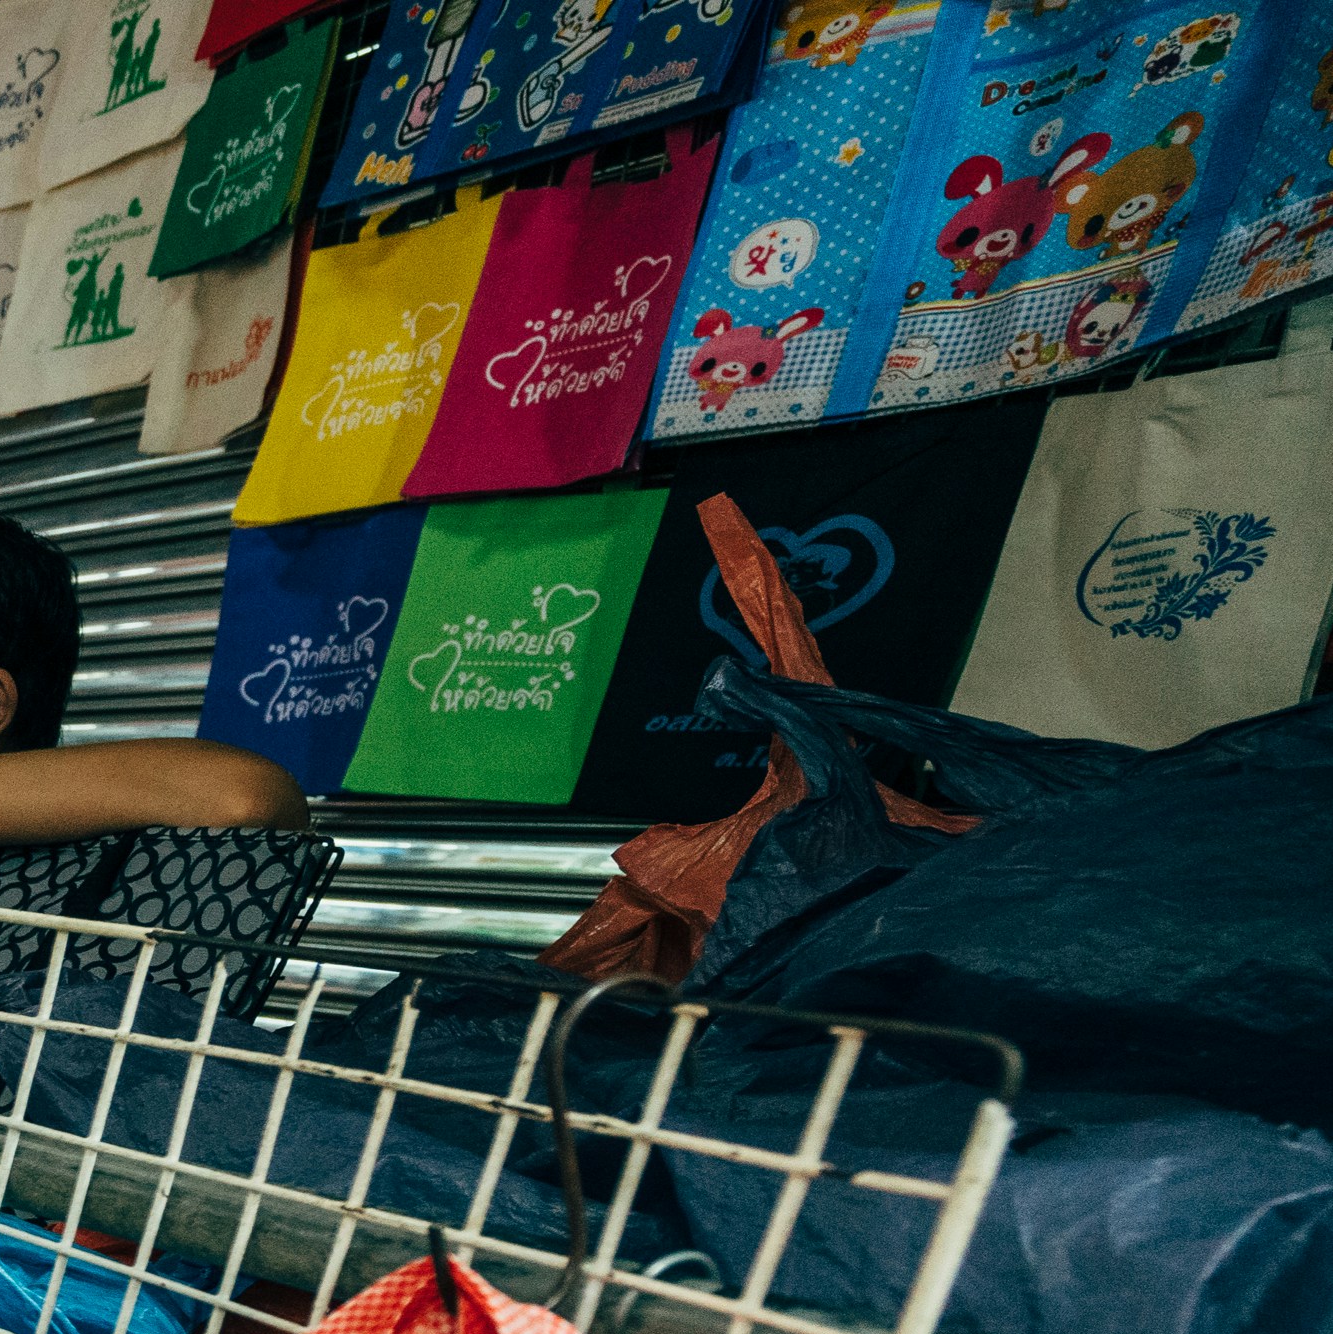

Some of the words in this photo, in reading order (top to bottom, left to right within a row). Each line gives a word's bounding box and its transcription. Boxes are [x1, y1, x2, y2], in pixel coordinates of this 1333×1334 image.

[485, 336, 633, 408] ให้ด้วยรัก
[407, 640, 561, 714] ให้ด้วยรัก
